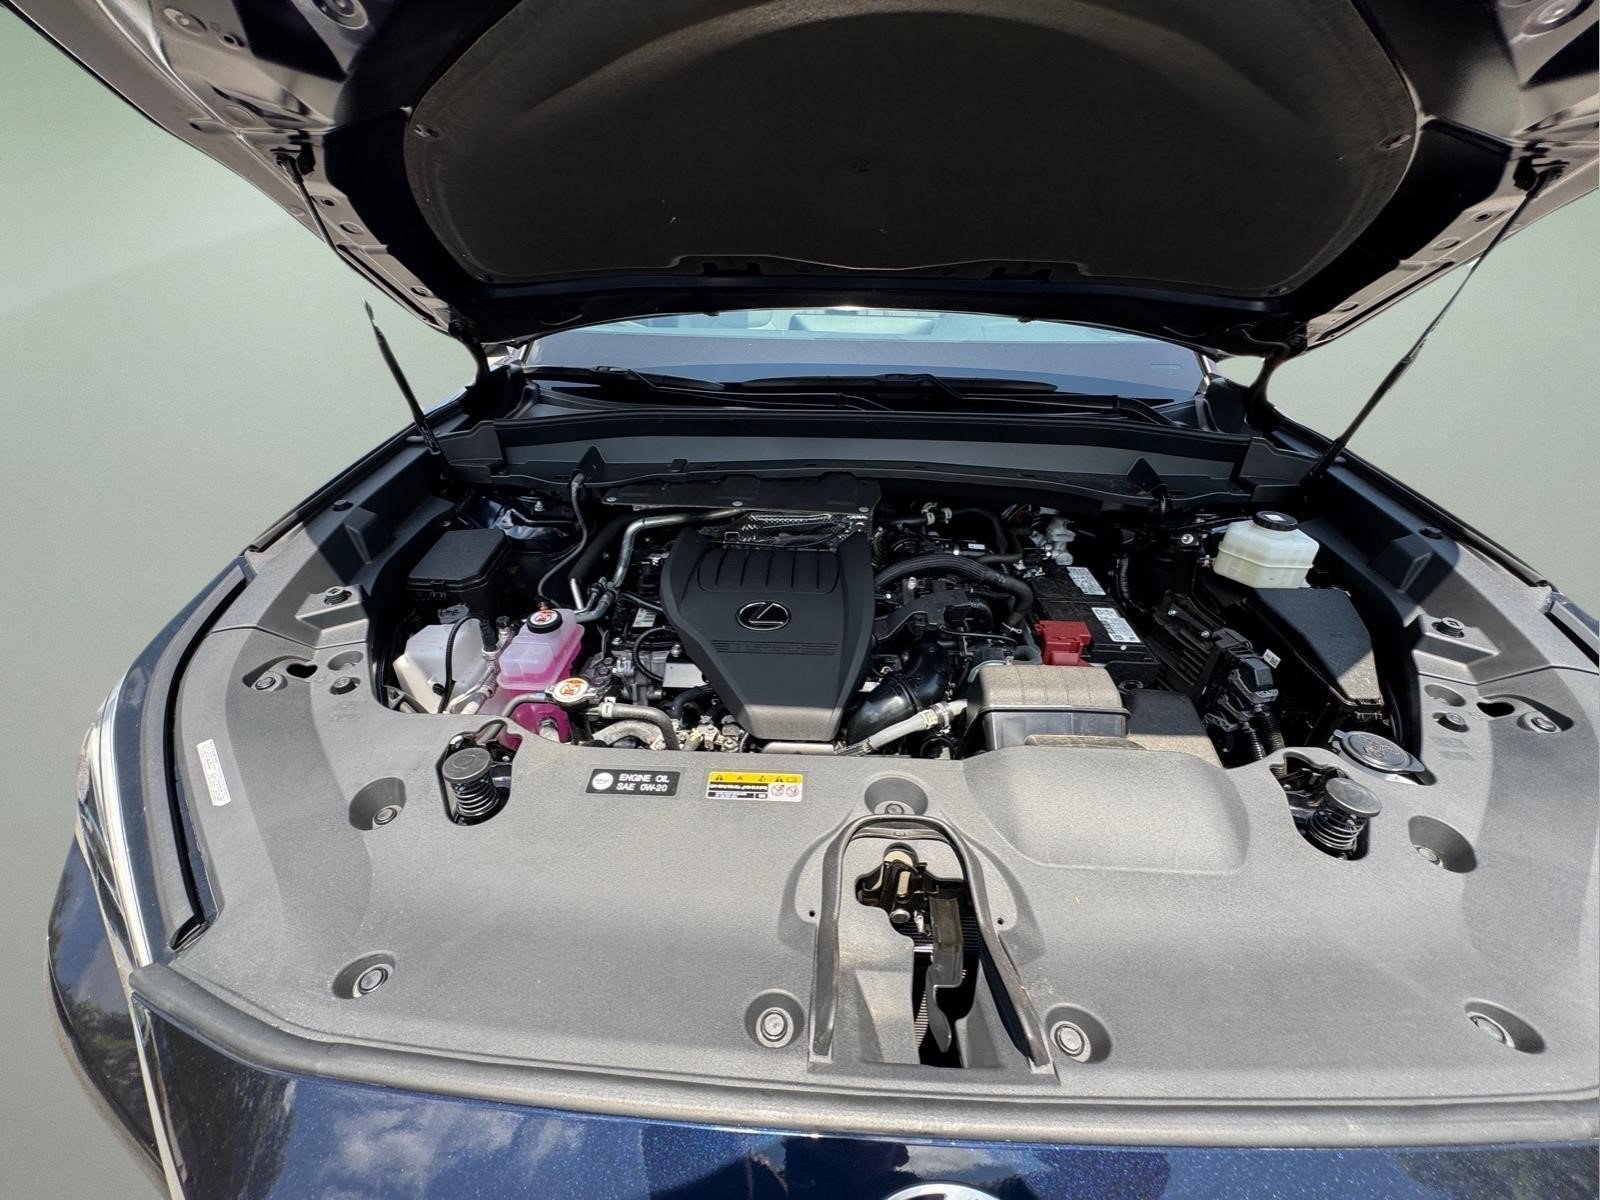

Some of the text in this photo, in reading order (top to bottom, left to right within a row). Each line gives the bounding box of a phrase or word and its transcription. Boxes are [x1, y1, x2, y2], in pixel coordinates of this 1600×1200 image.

[619, 773, 670, 783] ENGINE OIL
[616, 782, 668, 792] SAE 0W-20
